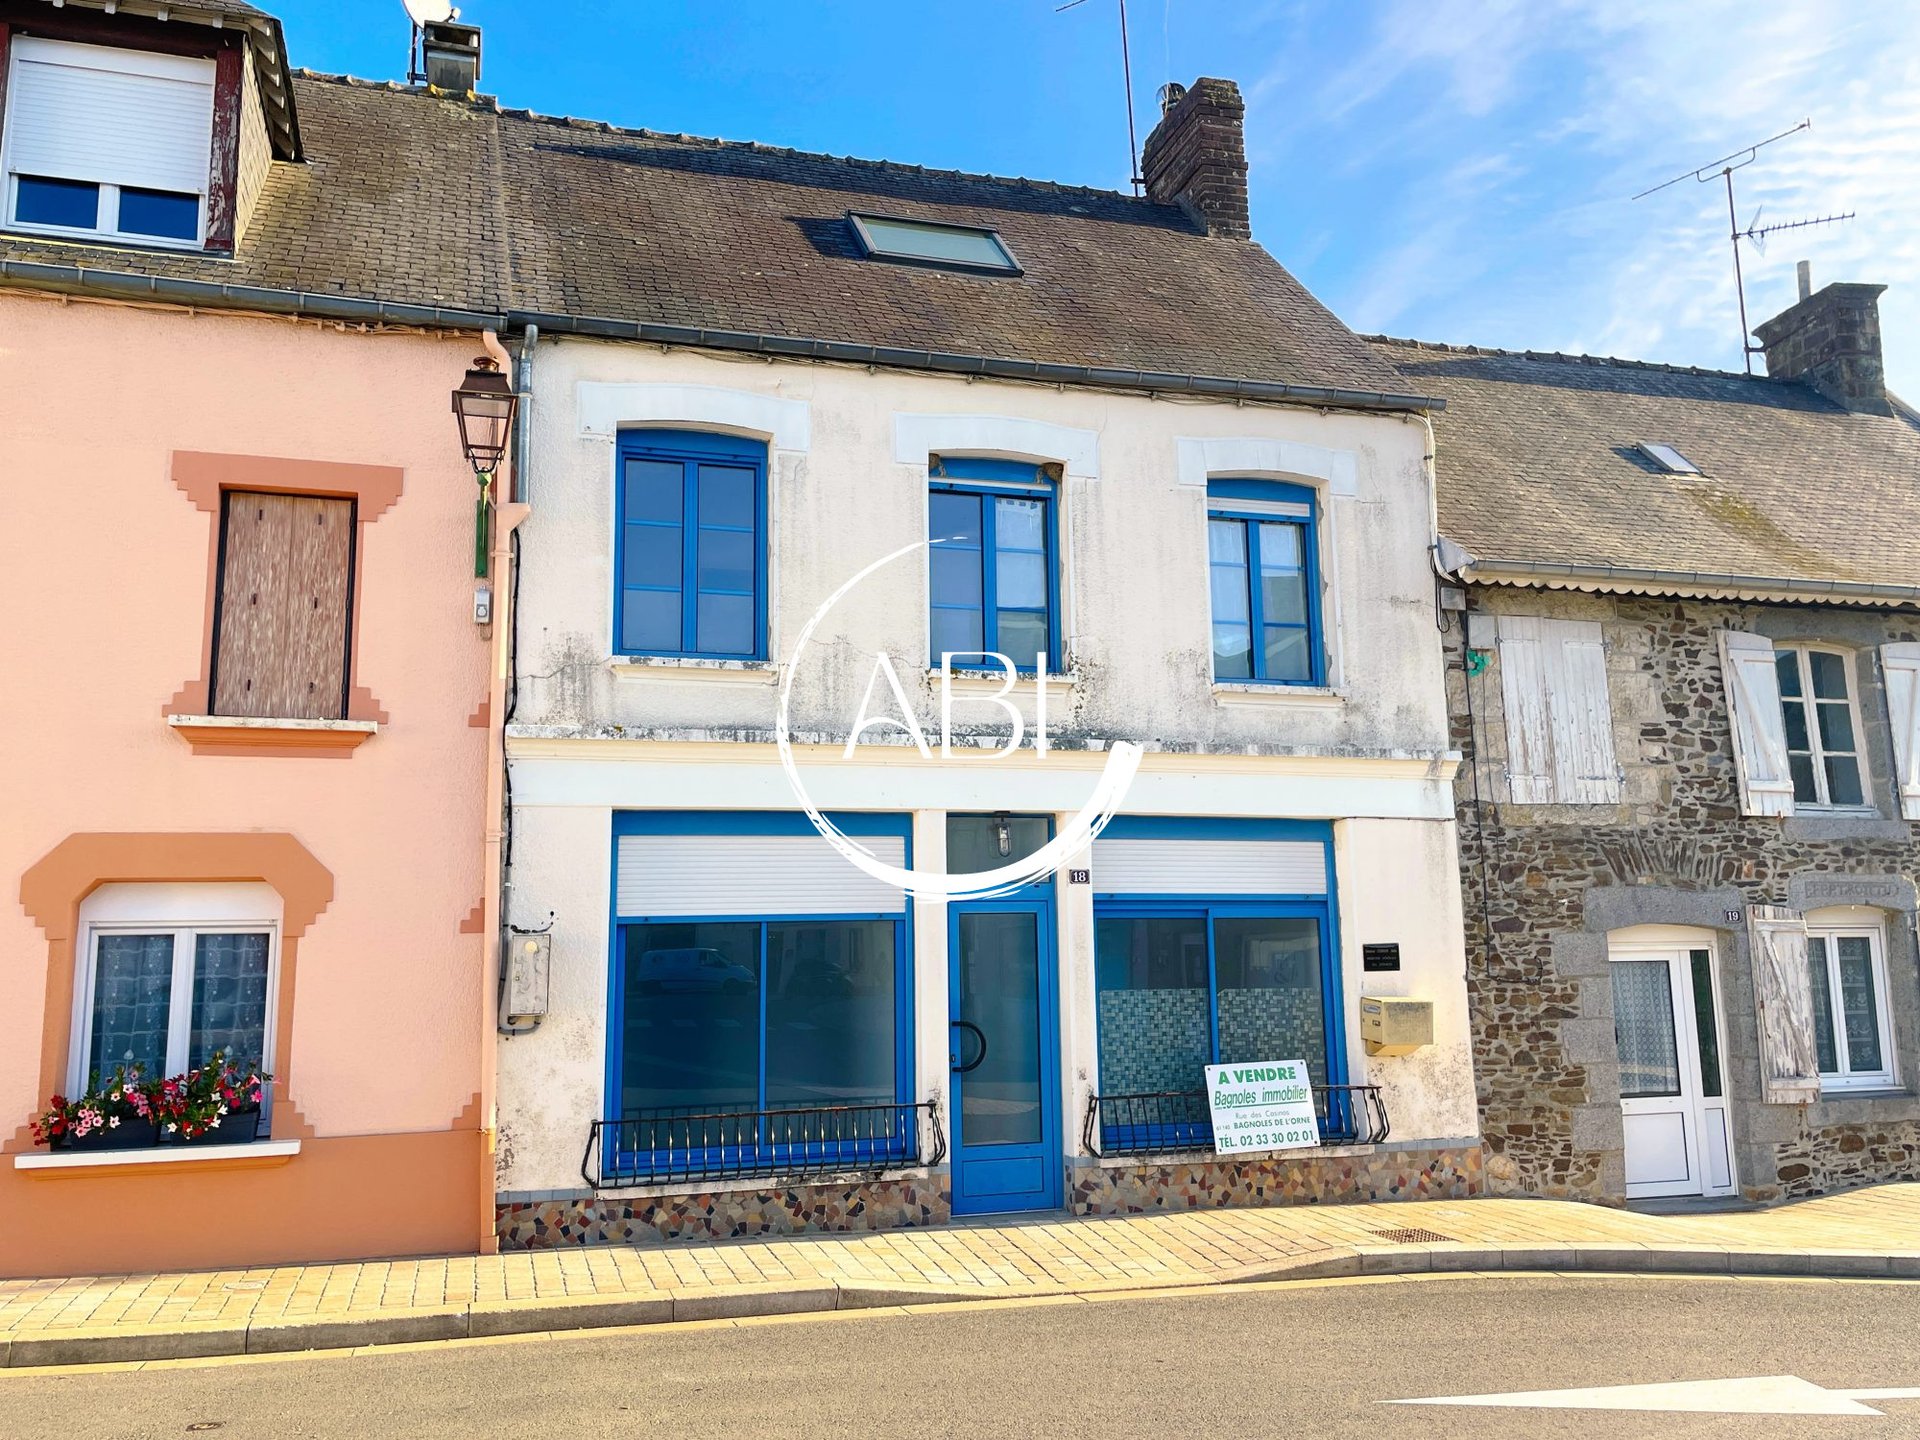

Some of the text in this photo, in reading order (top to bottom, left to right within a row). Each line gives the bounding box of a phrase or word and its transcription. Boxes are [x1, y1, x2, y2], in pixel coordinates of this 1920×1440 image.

[1073, 871, 1086, 882] 18
[1727, 911, 1739, 921] 19
[1219, 1066, 1297, 1085] A VENDRE
[1214, 1085, 1308, 1109] Bagnoles immobilier
[1234, 1119, 1273, 1129] BAGNOLES
[1274, 1118, 1284, 1126] DE
[1285, 1116, 1311, 1126] L'ORNE
[1219, 1130, 1314, 1148] TÉL. 02 33 30 02 01
